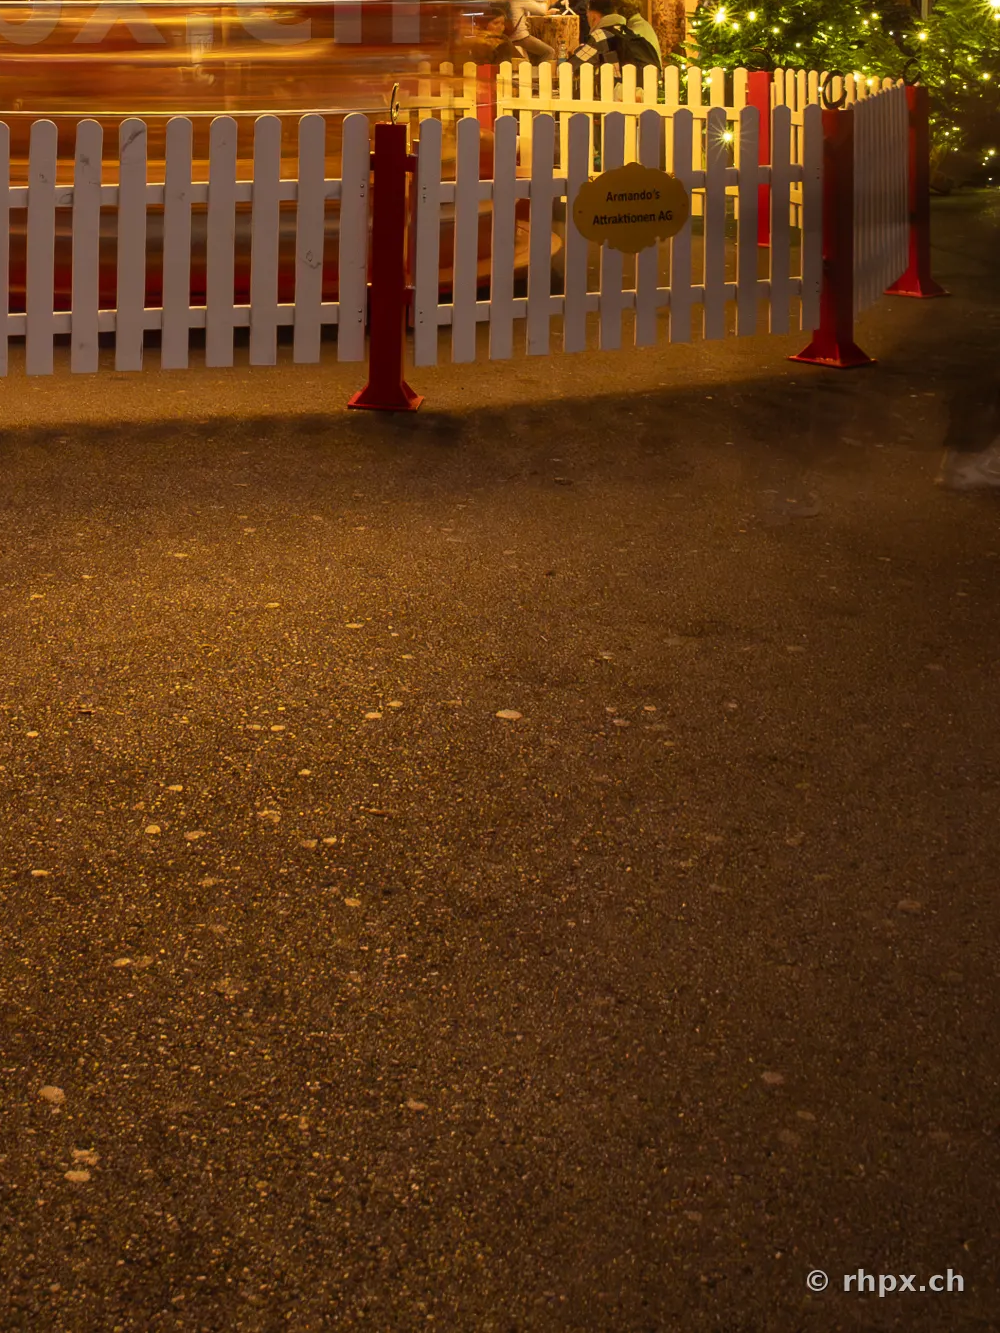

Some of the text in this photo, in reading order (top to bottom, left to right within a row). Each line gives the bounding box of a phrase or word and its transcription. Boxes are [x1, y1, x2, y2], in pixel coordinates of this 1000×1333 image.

[606, 188, 660, 202] Armando's
[592, 210, 674, 226] Attraktionen AG
